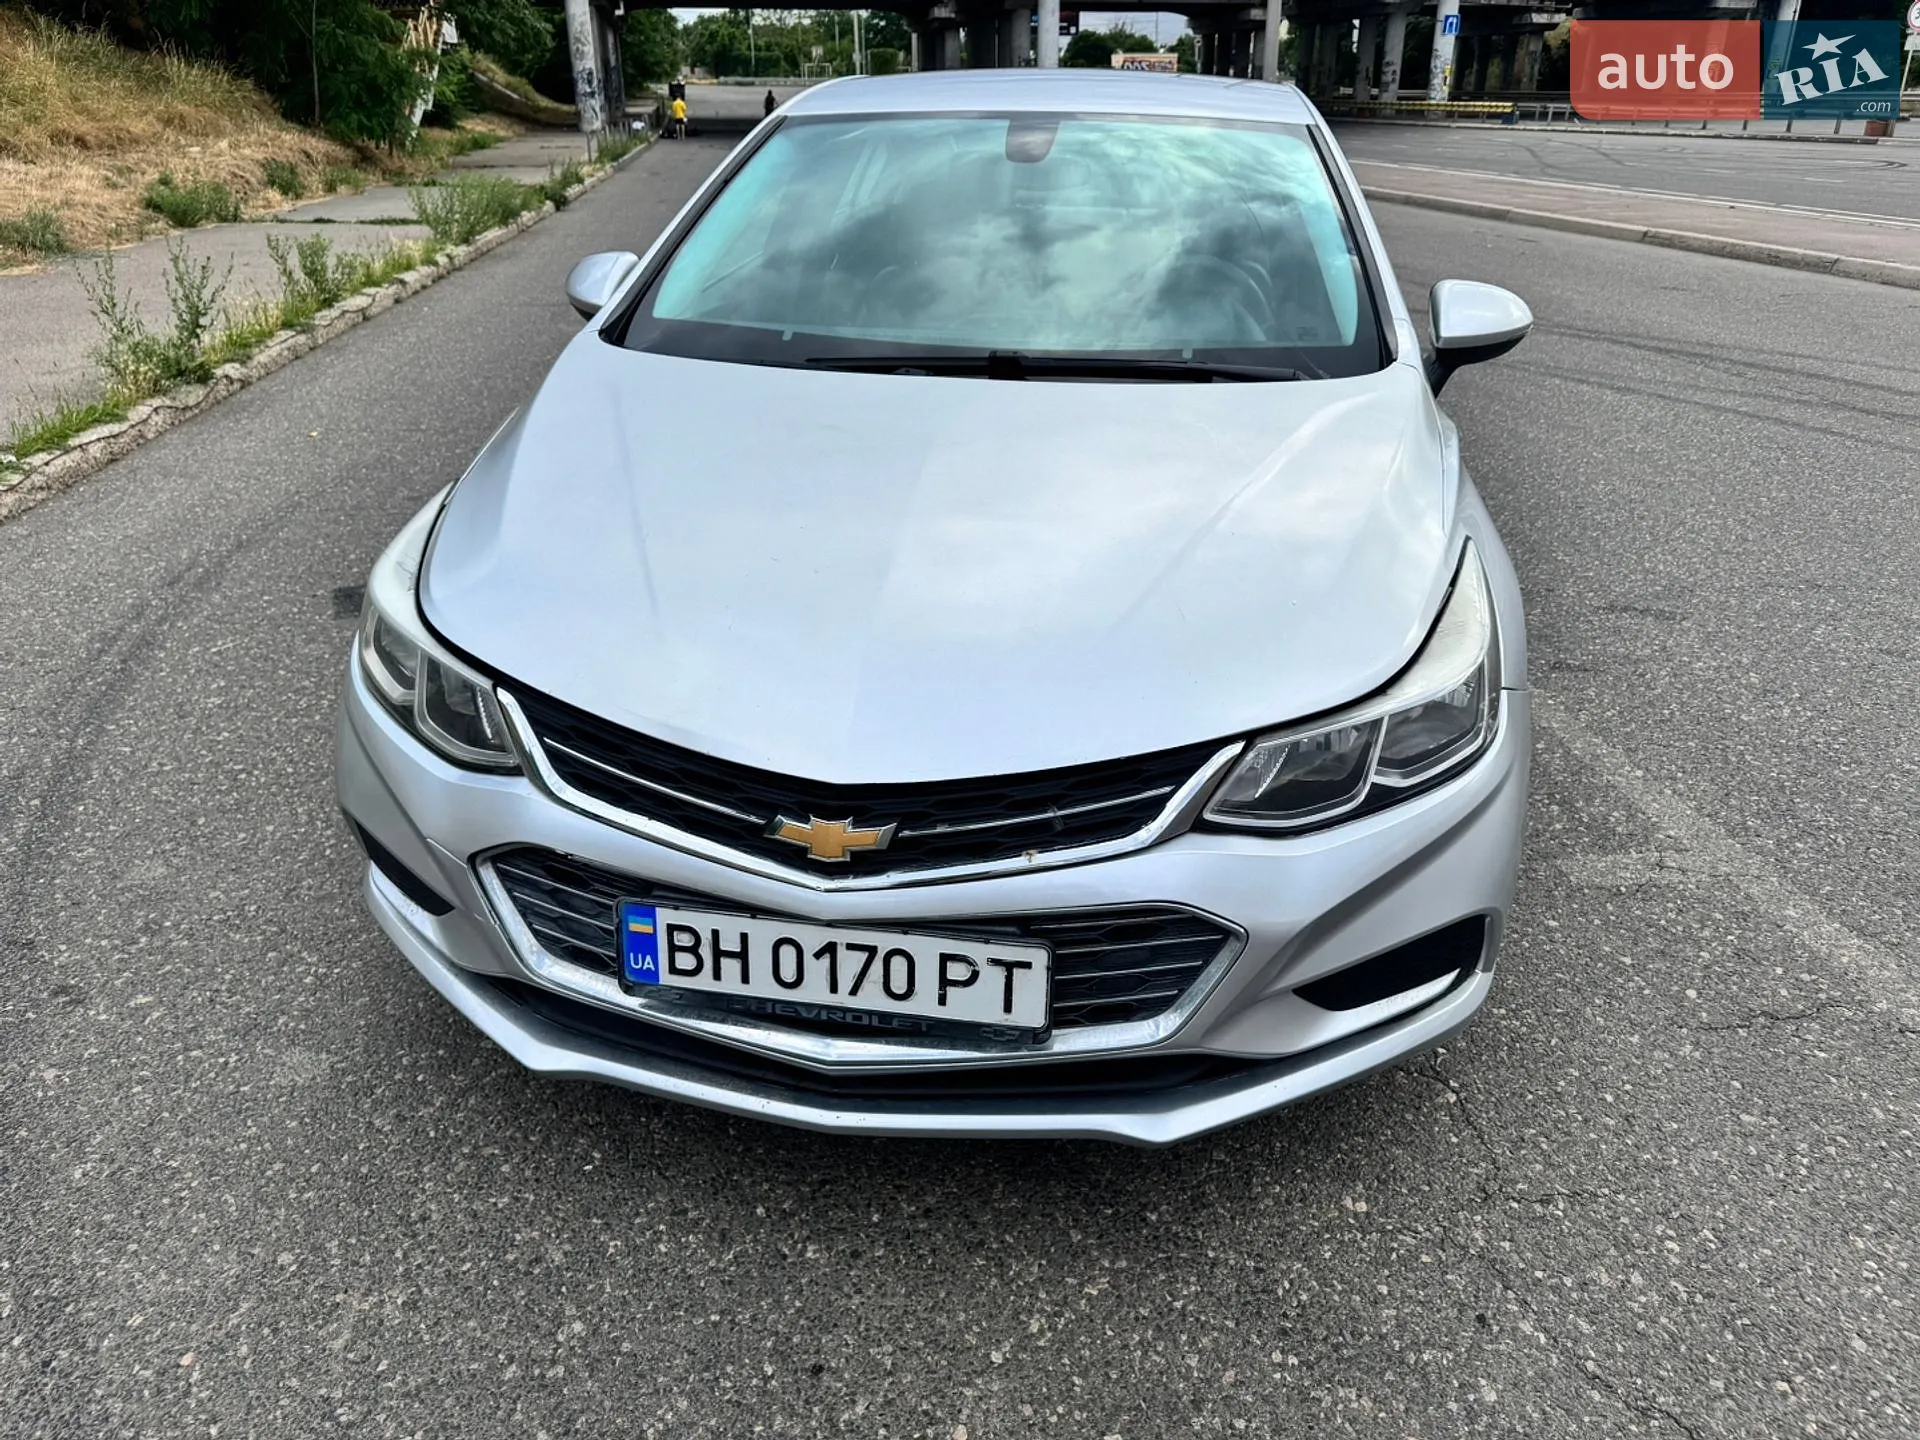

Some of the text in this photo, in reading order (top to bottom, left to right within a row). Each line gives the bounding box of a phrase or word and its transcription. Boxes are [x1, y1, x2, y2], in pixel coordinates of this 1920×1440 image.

[629, 952, 656, 972] UA
[666, 922, 1033, 1015] BH 0170 PT
[726, 999, 935, 1032] CHEVROLET
